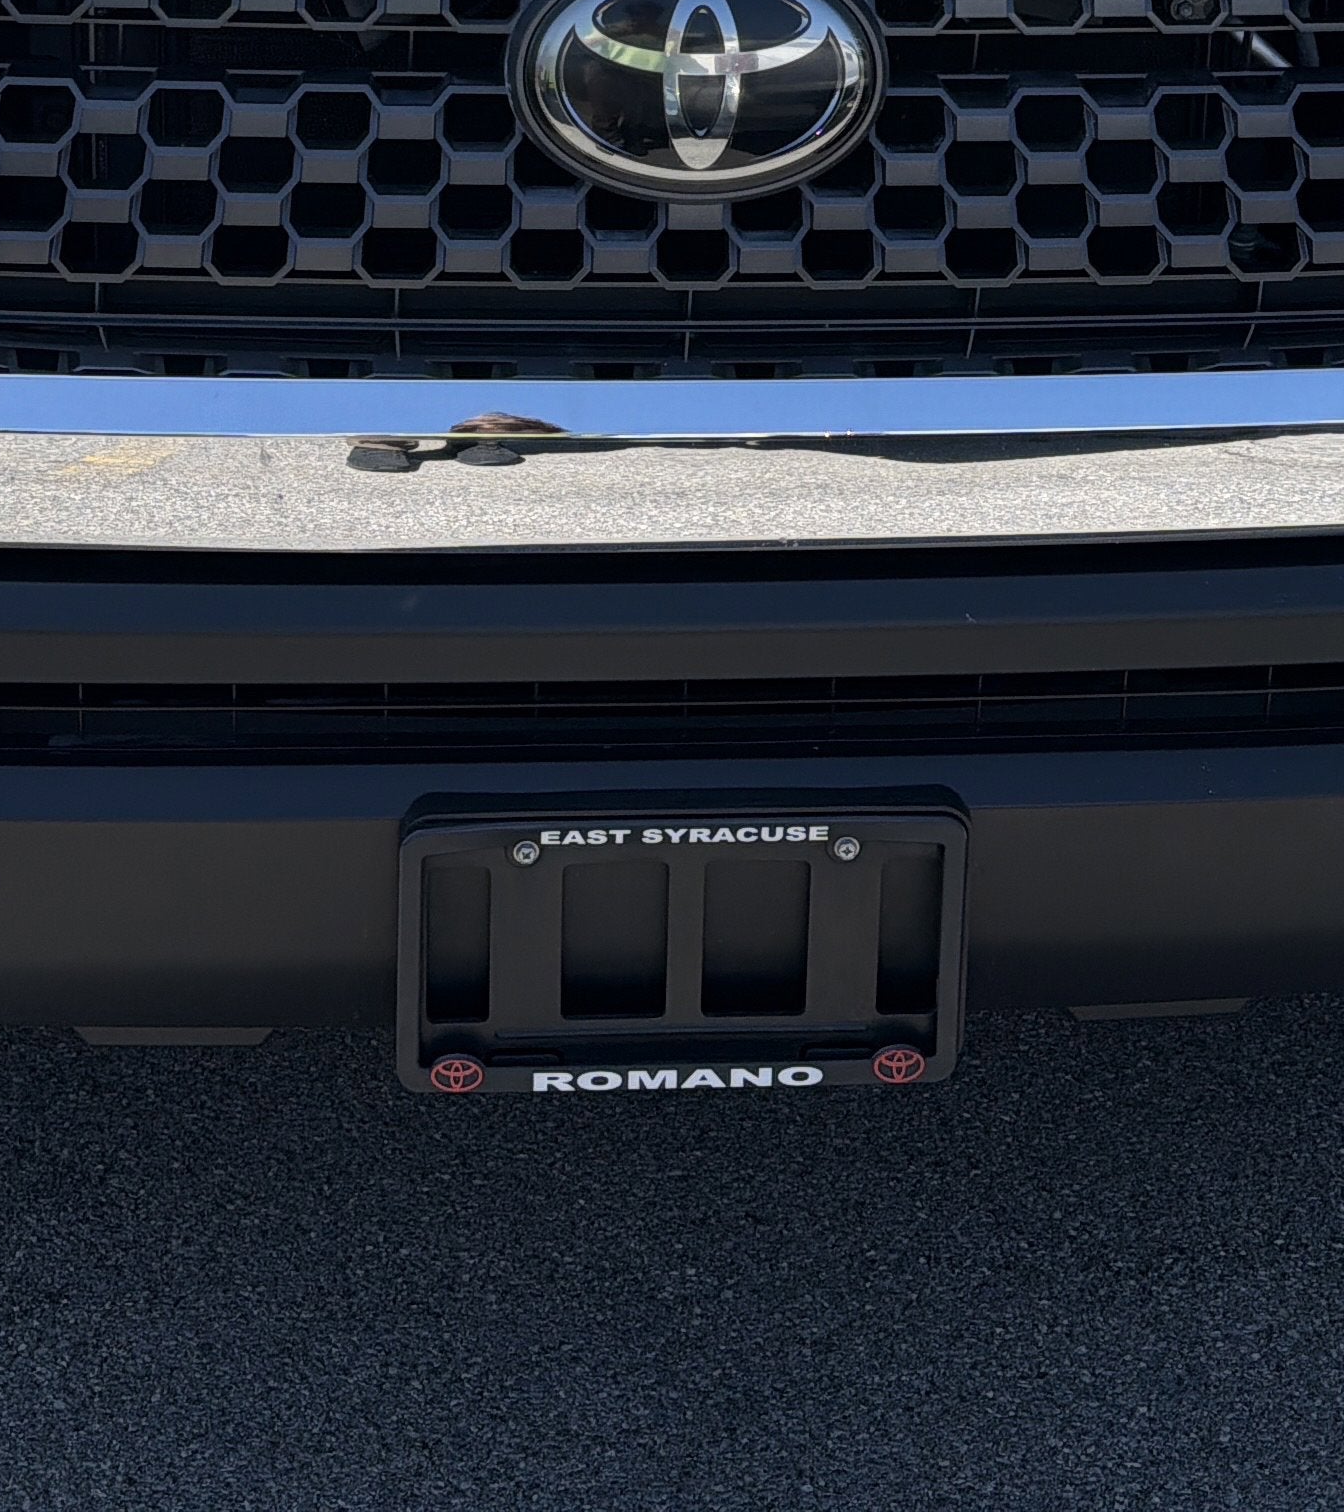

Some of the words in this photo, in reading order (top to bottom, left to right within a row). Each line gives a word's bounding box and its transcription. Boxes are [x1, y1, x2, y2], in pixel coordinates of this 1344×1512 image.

[539, 829, 631, 846] EAST
[641, 825, 830, 845] SYRACUSE
[532, 1066, 824, 1092] ROMANO
